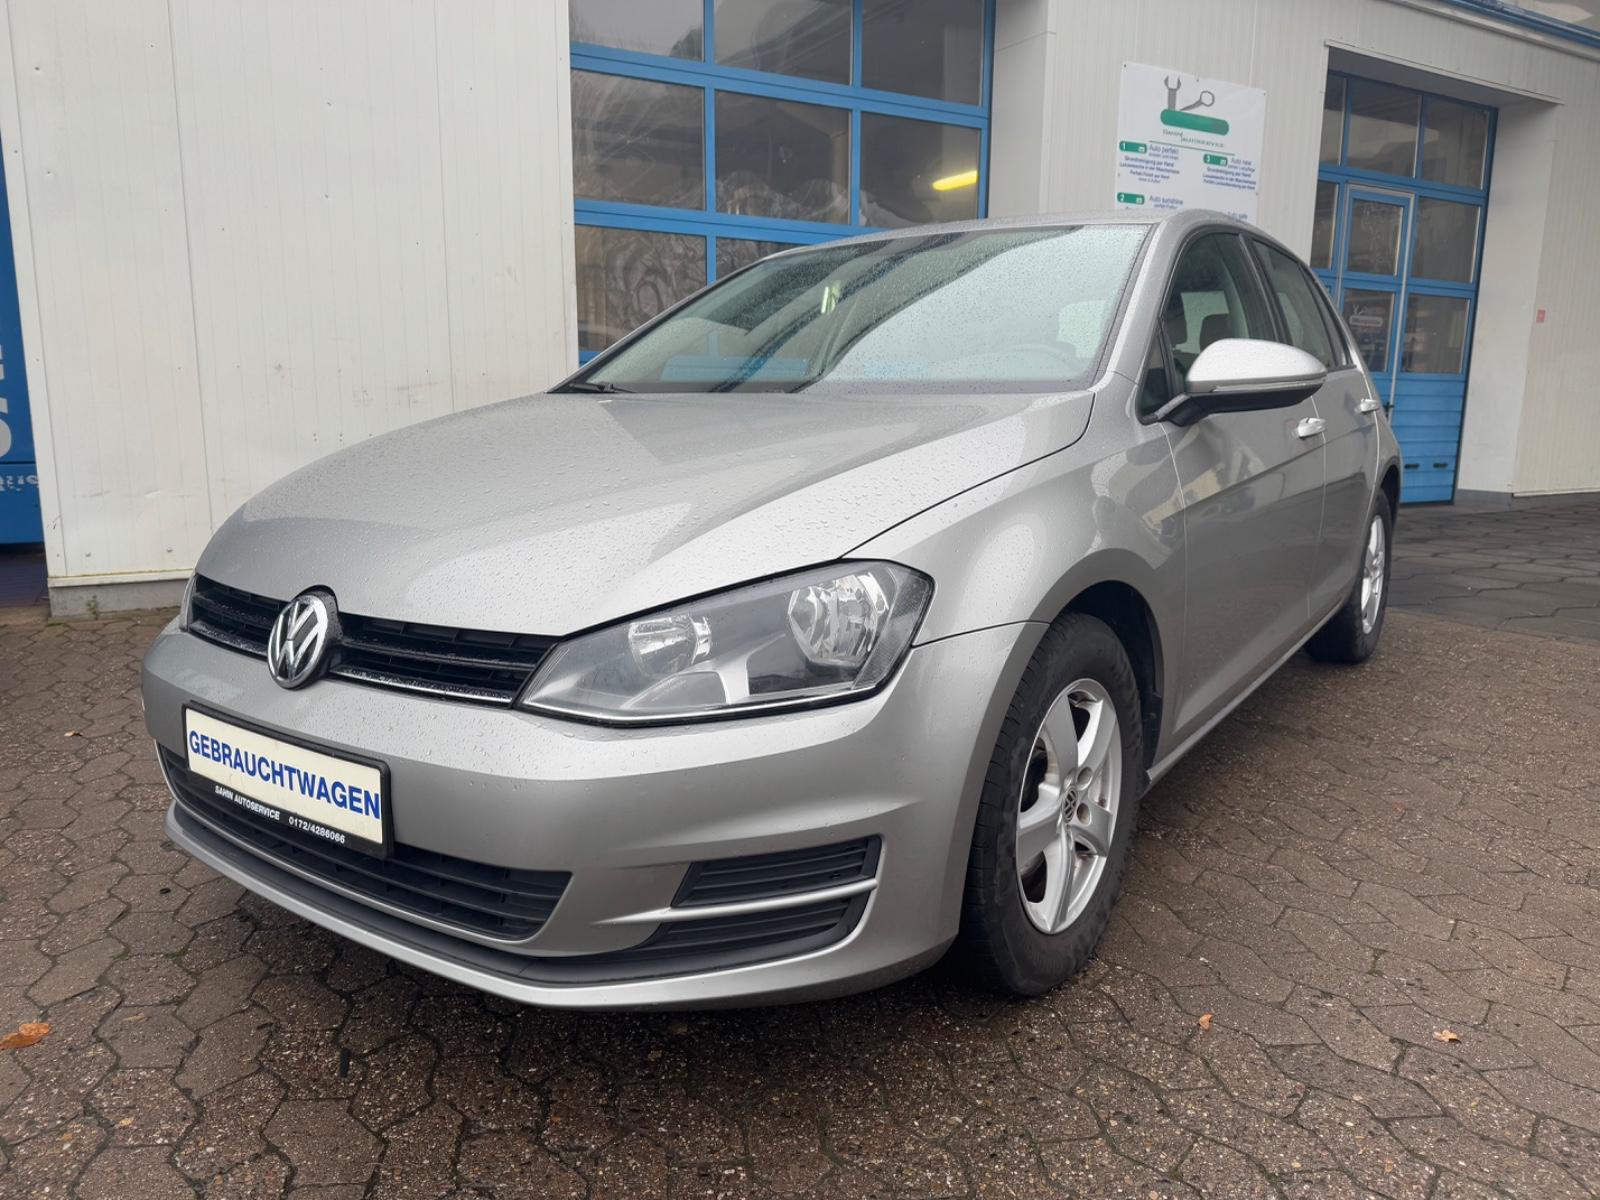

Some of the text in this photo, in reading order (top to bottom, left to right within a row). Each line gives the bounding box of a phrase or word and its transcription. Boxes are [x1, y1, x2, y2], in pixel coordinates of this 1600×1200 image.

[189, 730, 380, 820] GEBRAUCHTWAGEN
[214, 785, 234, 800] SAHIN
[234, 793, 281, 820] AUTOSERVICE
